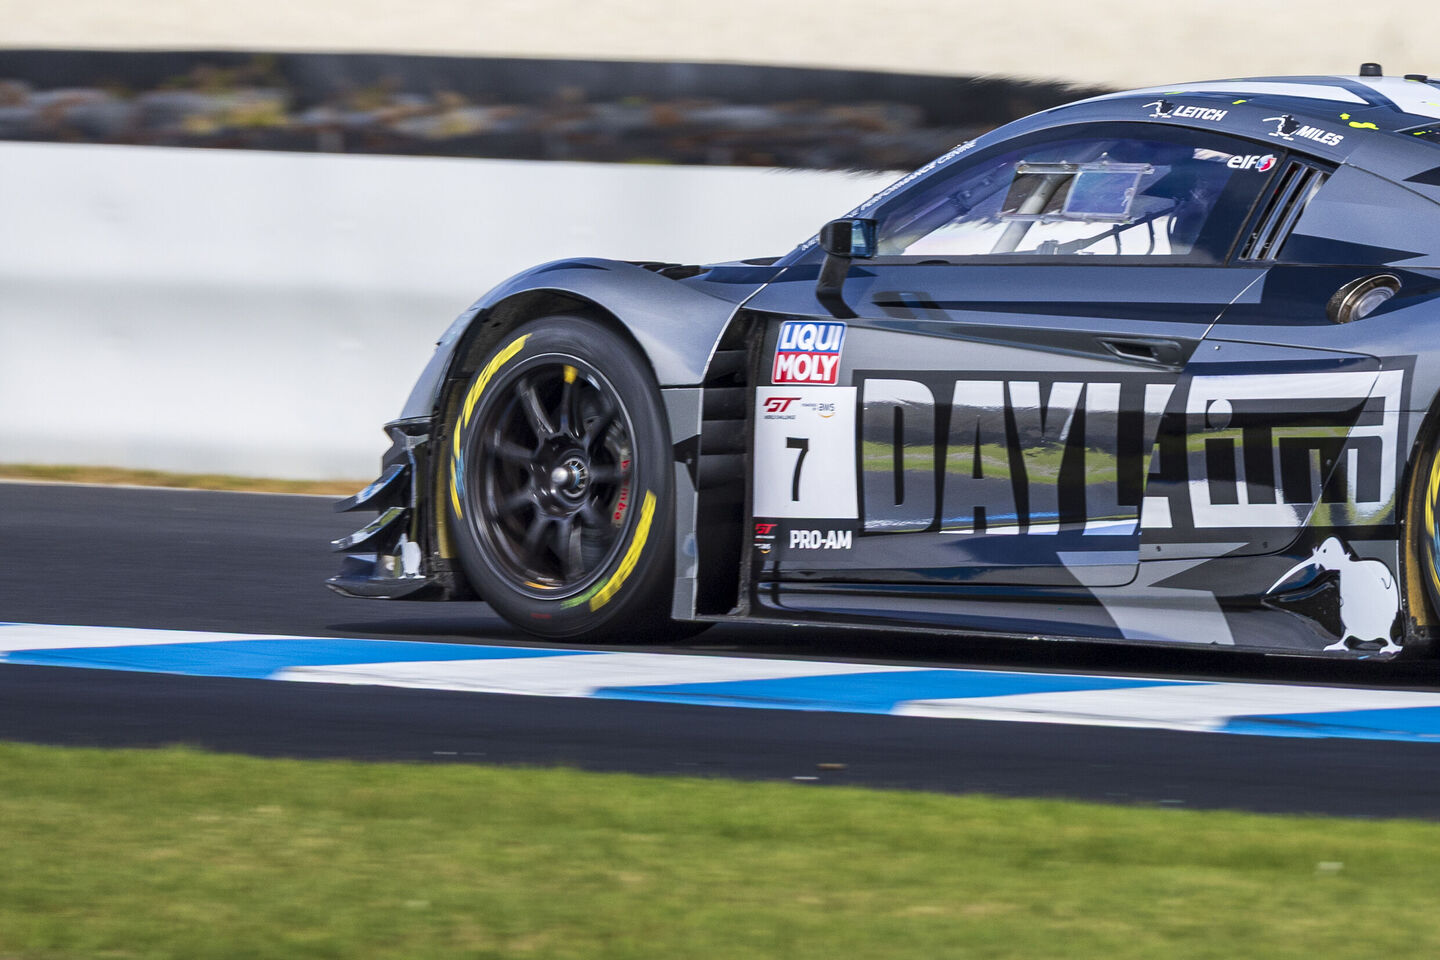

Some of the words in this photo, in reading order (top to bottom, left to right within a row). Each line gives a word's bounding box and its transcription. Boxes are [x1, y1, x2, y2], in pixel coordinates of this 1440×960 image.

[1173, 105, 1229, 121] LEITCH
[1296, 125, 1344, 146] MILES
[1227, 154, 1262, 169] elf
[780, 324, 843, 351] LIQUI
[776, 353, 840, 381] MOLY
[763, 397, 802, 413] GT
[785, 437, 809, 501] 7
[789, 530, 852, 549] PRO-AM
